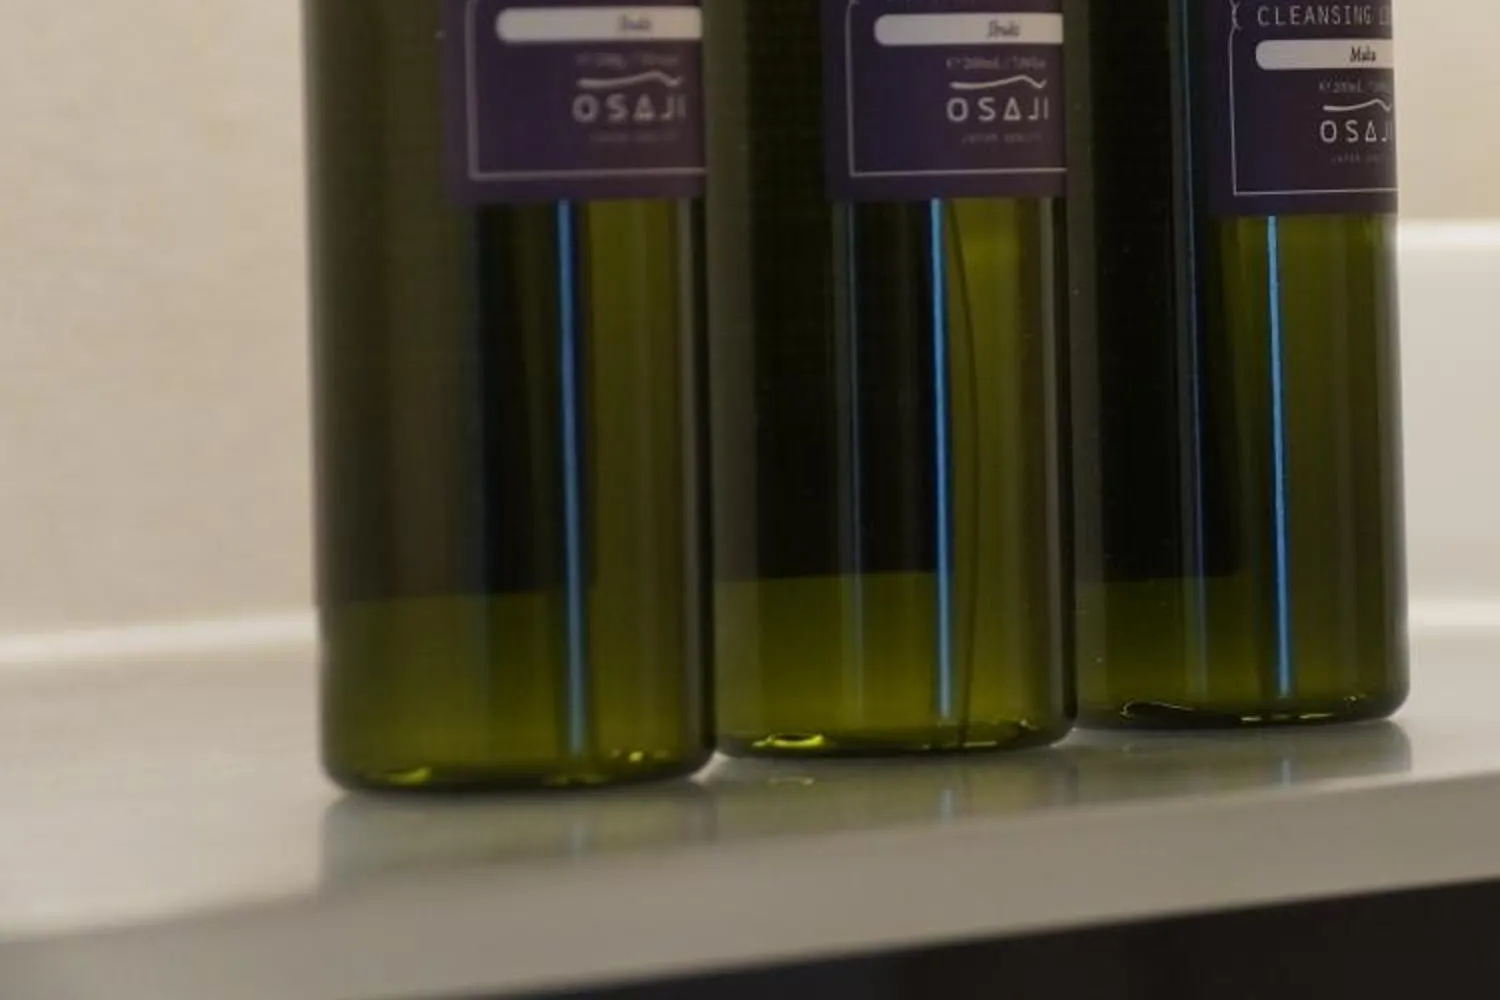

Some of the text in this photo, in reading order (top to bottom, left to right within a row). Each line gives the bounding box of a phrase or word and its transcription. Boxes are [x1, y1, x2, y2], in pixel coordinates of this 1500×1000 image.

[1257, 4, 1371, 26] CLEANSING
[572, 93, 687, 123] OSAJI
[946, 96, 1050, 122] OSAJI
